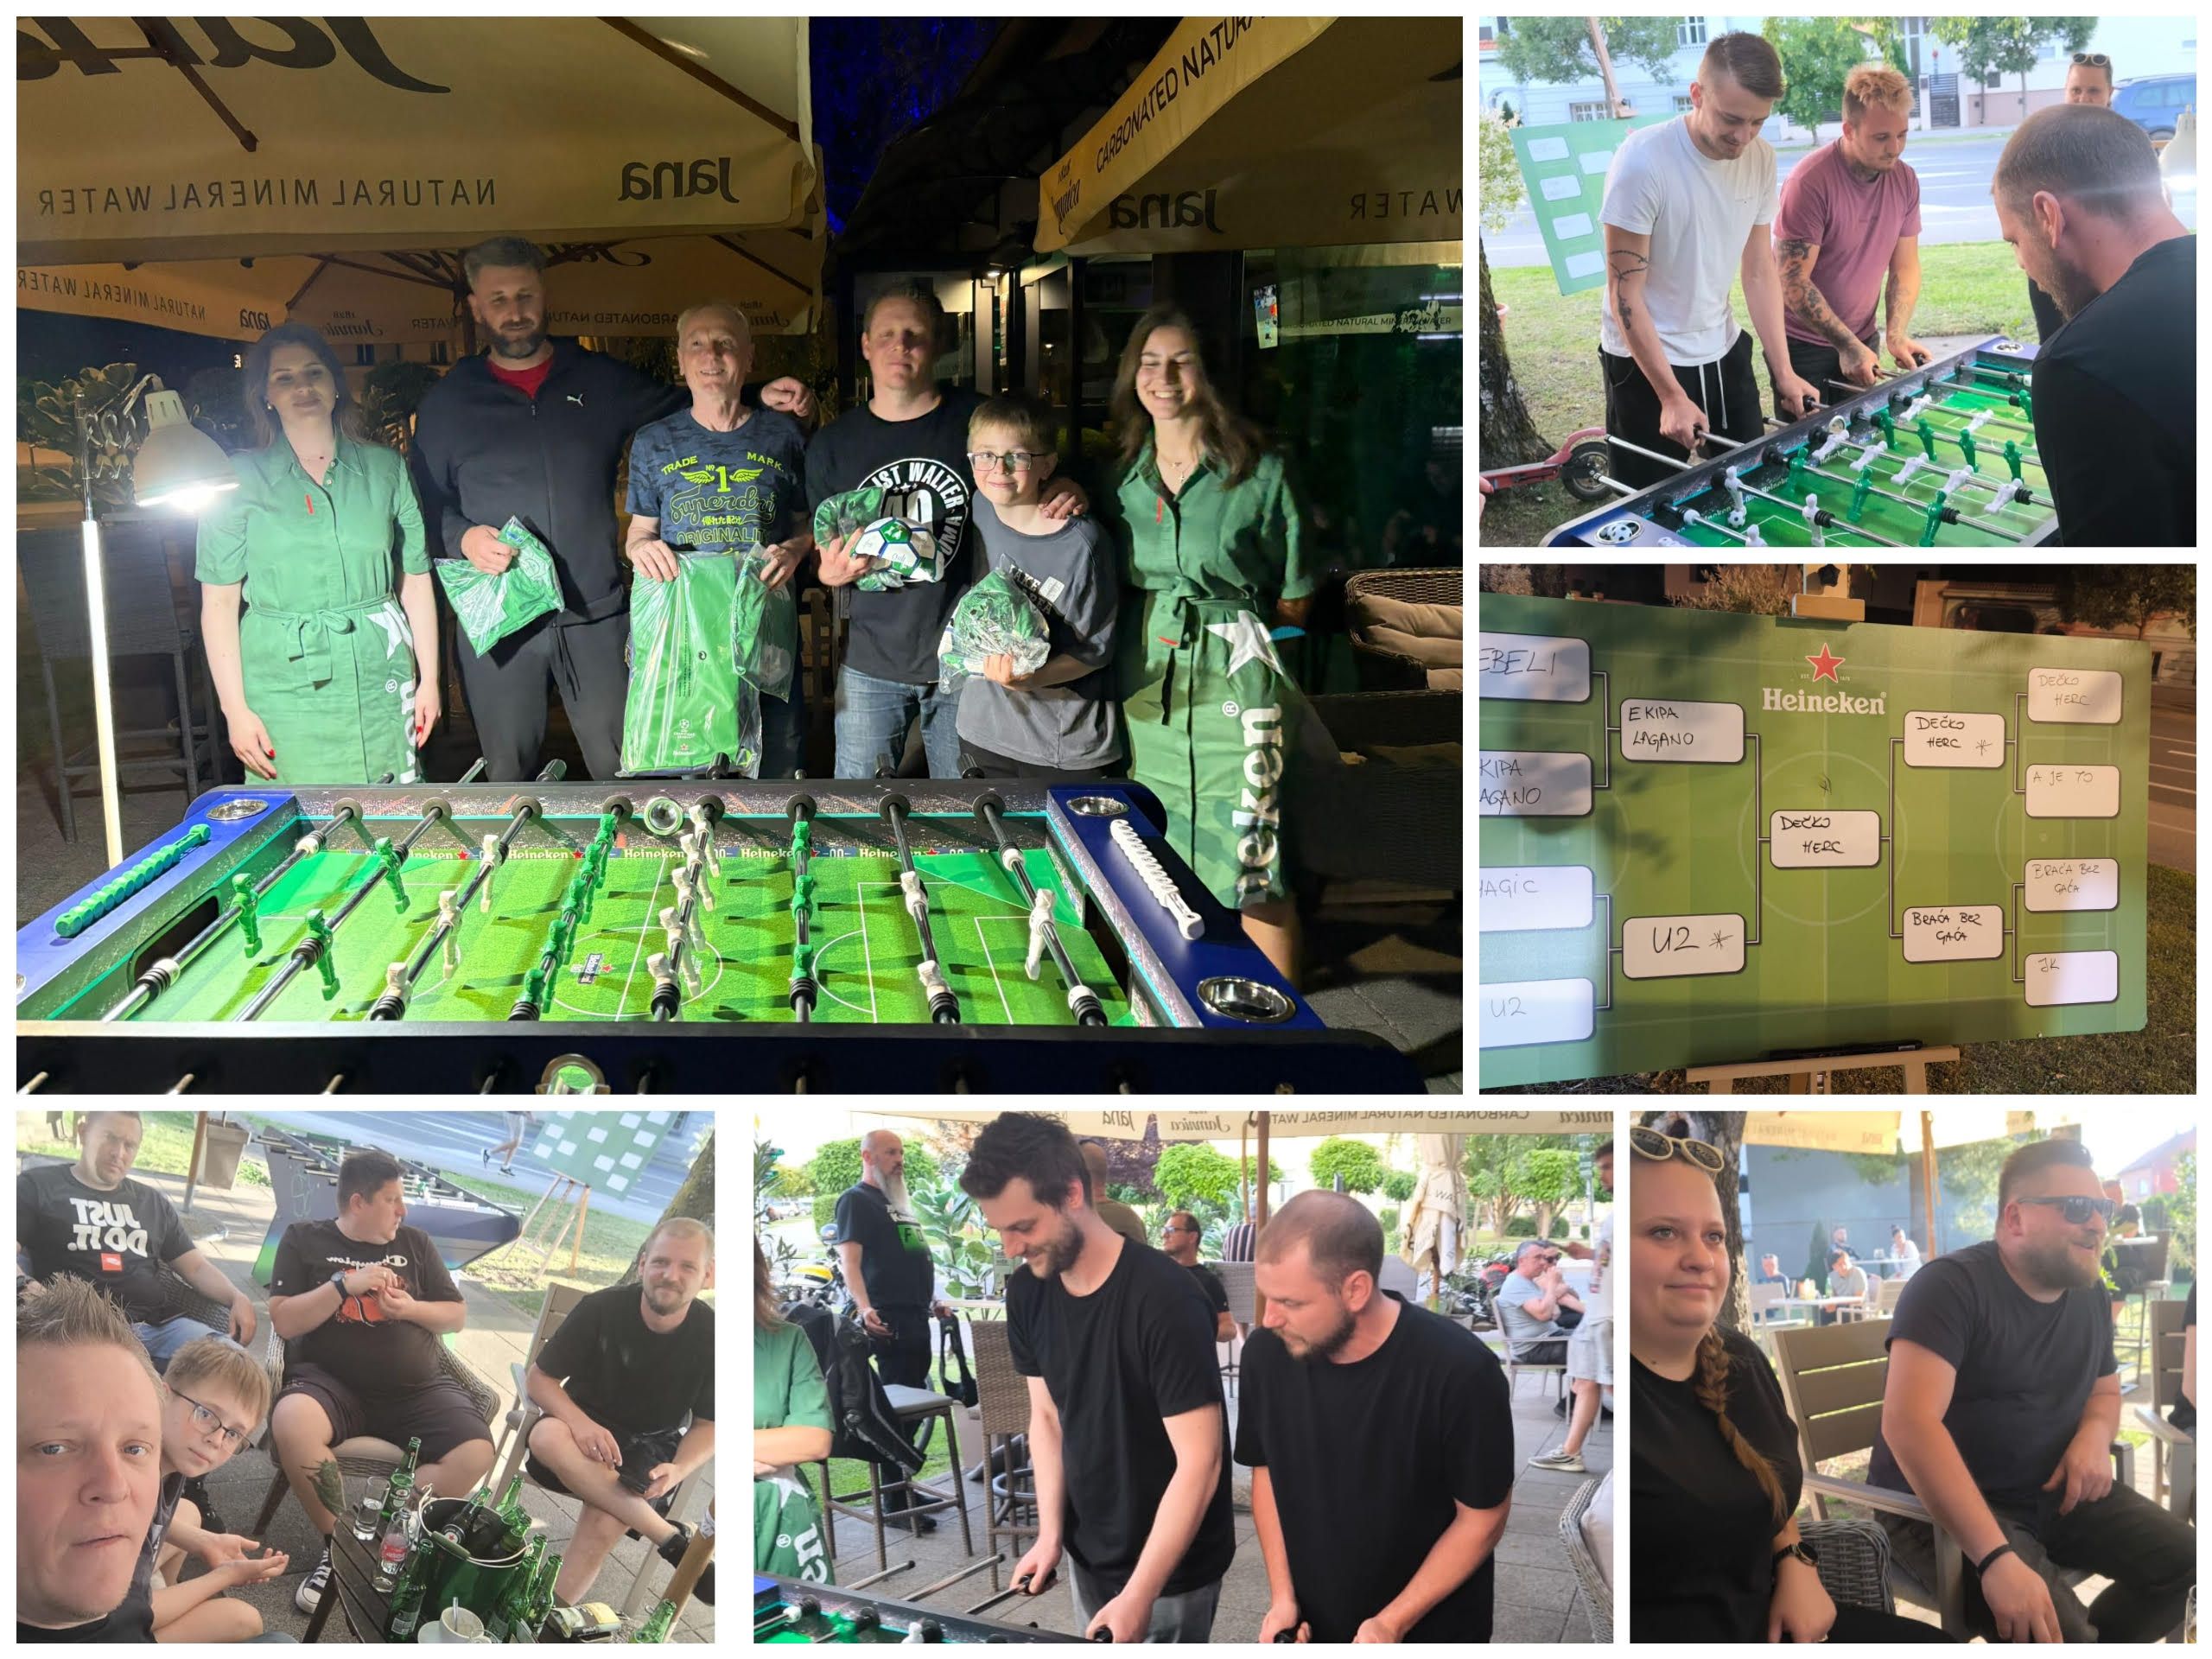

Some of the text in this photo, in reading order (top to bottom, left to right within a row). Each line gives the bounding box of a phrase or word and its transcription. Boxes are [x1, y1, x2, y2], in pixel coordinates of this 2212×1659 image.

[1096, 67, 1179, 173] CARBONATED
[1337, 317, 1378, 326] NATURAL
[661, 455, 698, 476] TRADE
[715, 466, 731, 493] 1
[909, 462, 965, 509] WALTER
[2037, 673, 2079, 687] DEČKO
[1763, 688, 1885, 715] Heineken
[2054, 694, 2091, 706] HERC
[1629, 707, 1679, 721] EKIPA
[1915, 715, 1965, 730] DEČKO
[1633, 731, 1694, 753] LAGANO
[1927, 738, 1961, 748] HERC
[1780, 815, 1831, 830] DEČKO
[510, 849, 568, 859] Heineken
[624, 849, 683, 859] Heineken
[1802, 841, 1845, 854] HERC
[1652, 926, 1700, 954] U2
[1491, 997, 1527, 1018] U2
